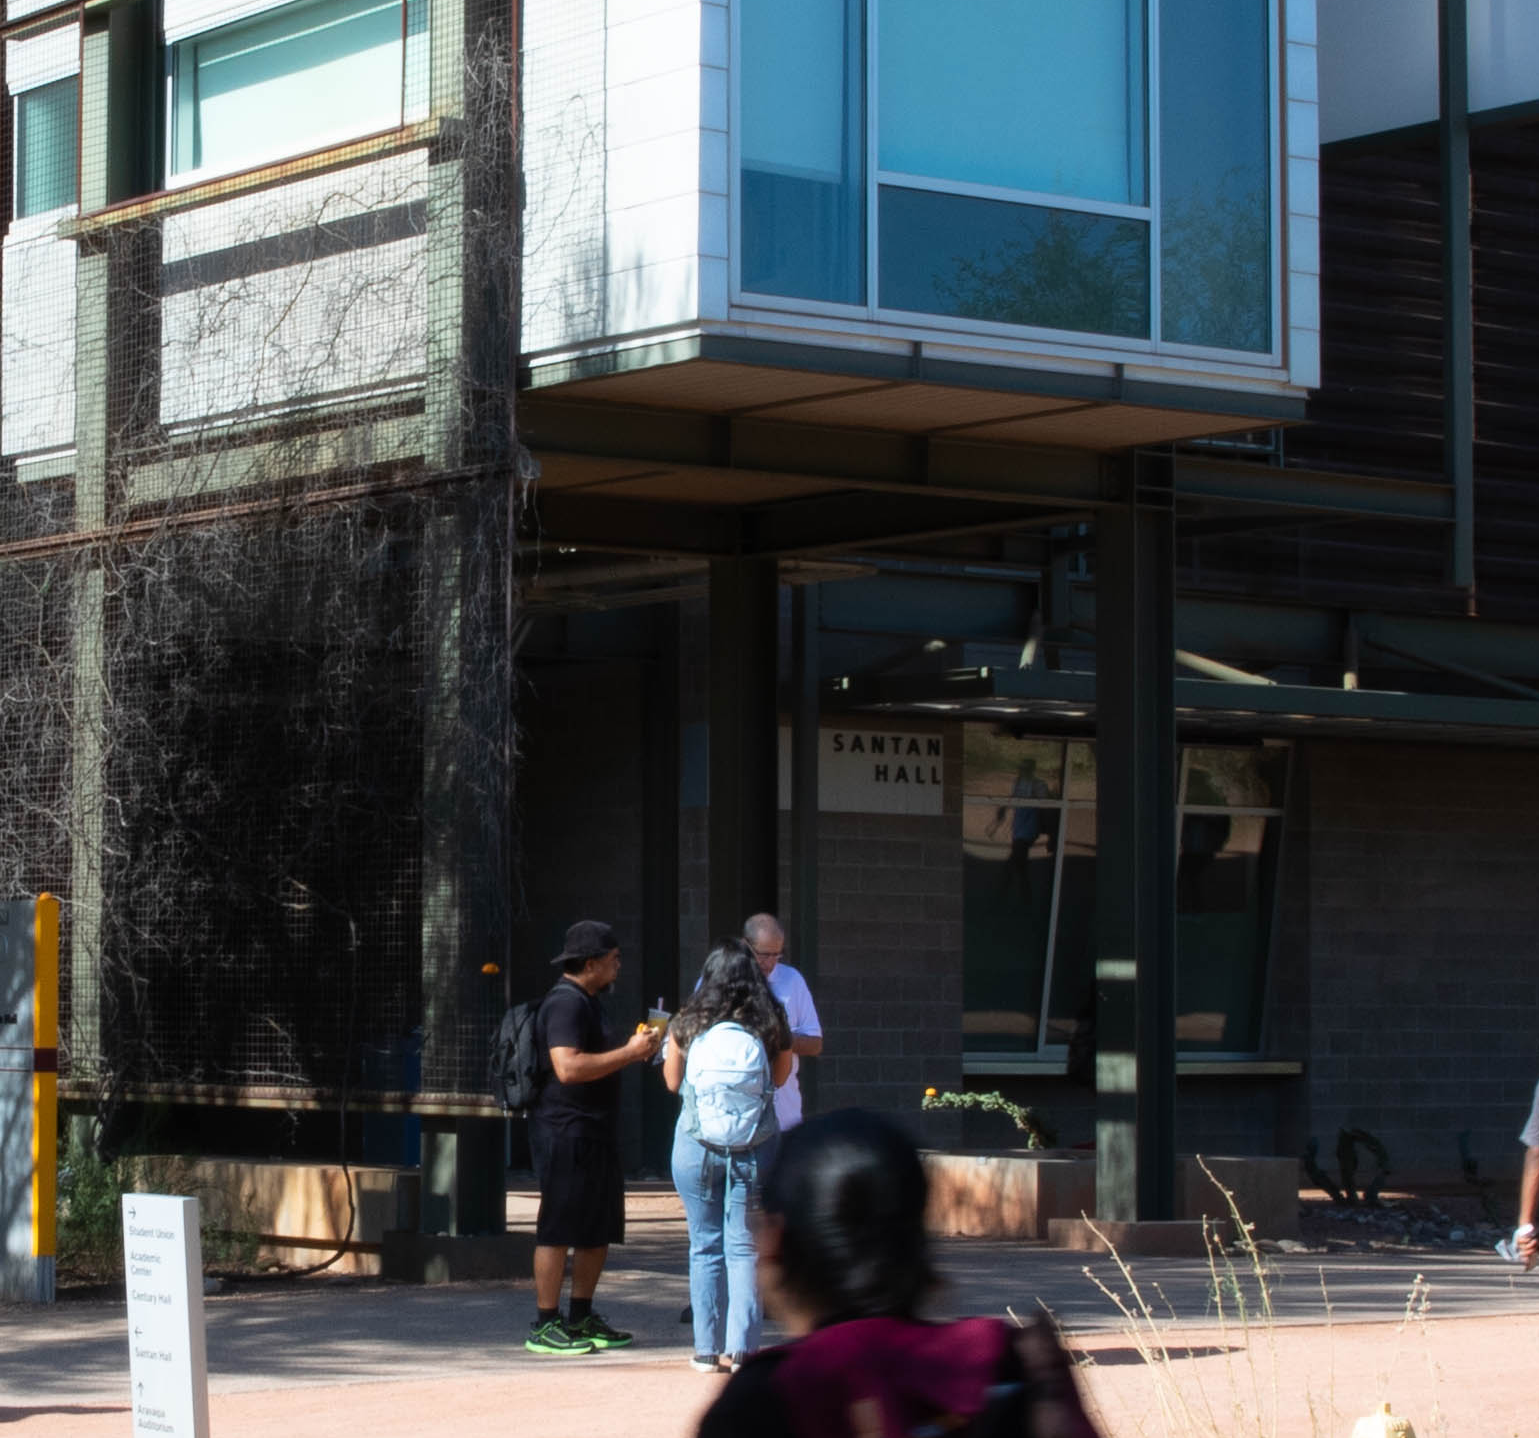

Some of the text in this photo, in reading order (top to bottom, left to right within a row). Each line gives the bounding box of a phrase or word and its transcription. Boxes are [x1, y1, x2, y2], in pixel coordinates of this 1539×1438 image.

[833, 733, 940, 756] SANTAN
[875, 764, 940, 785] HALL
[129, 1225, 175, 1240] Student Union
[130, 1249, 161, 1264] Academic
[131, 1264, 152, 1277] Center
[132, 1289, 172, 1305] Century Hall
[135, 1346, 172, 1362] Santan Hall
[137, 1418, 174, 1433] Auditorium
